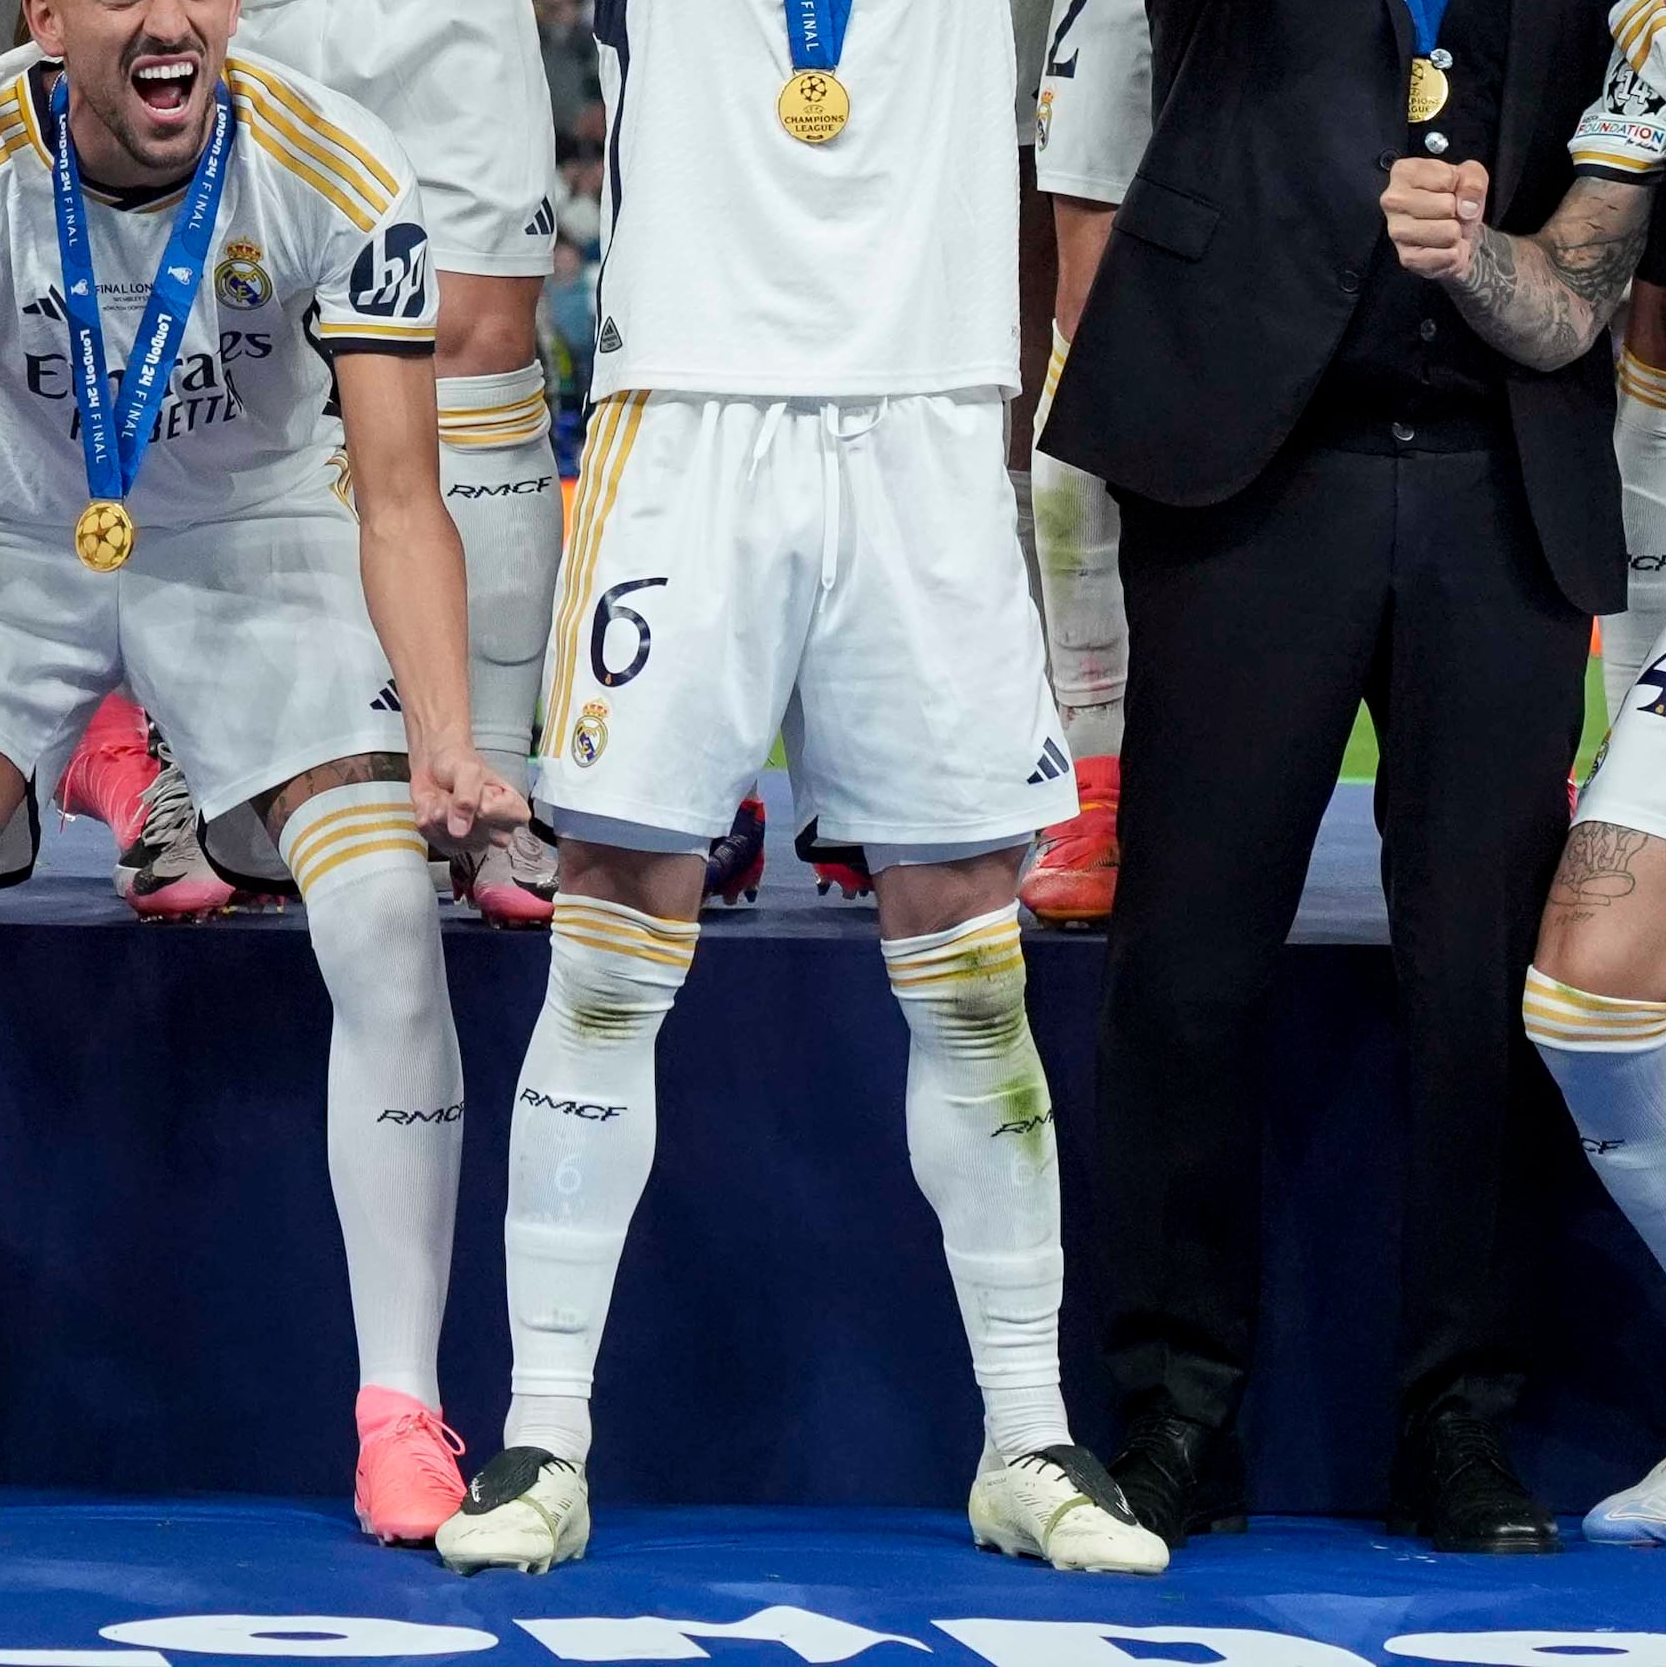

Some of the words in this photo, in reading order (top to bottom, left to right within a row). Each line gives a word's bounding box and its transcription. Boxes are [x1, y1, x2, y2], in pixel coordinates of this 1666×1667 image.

[800, 1, 818, 52] FINAL
[1613, 75, 1648, 102] 14
[784, 115, 844, 125] CHAMPIONS
[796, 124, 834, 133] LEAGUE
[1576, 122, 1666, 144] FOUNDATION
[350, 223, 428, 317] hp
[139, 365, 155, 386] 24
[123, 391, 149, 439] FINAL
[448, 475, 553, 498] RMCF
[590, 577, 668, 688] 6
[519, 1088, 627, 1121] RMCF
